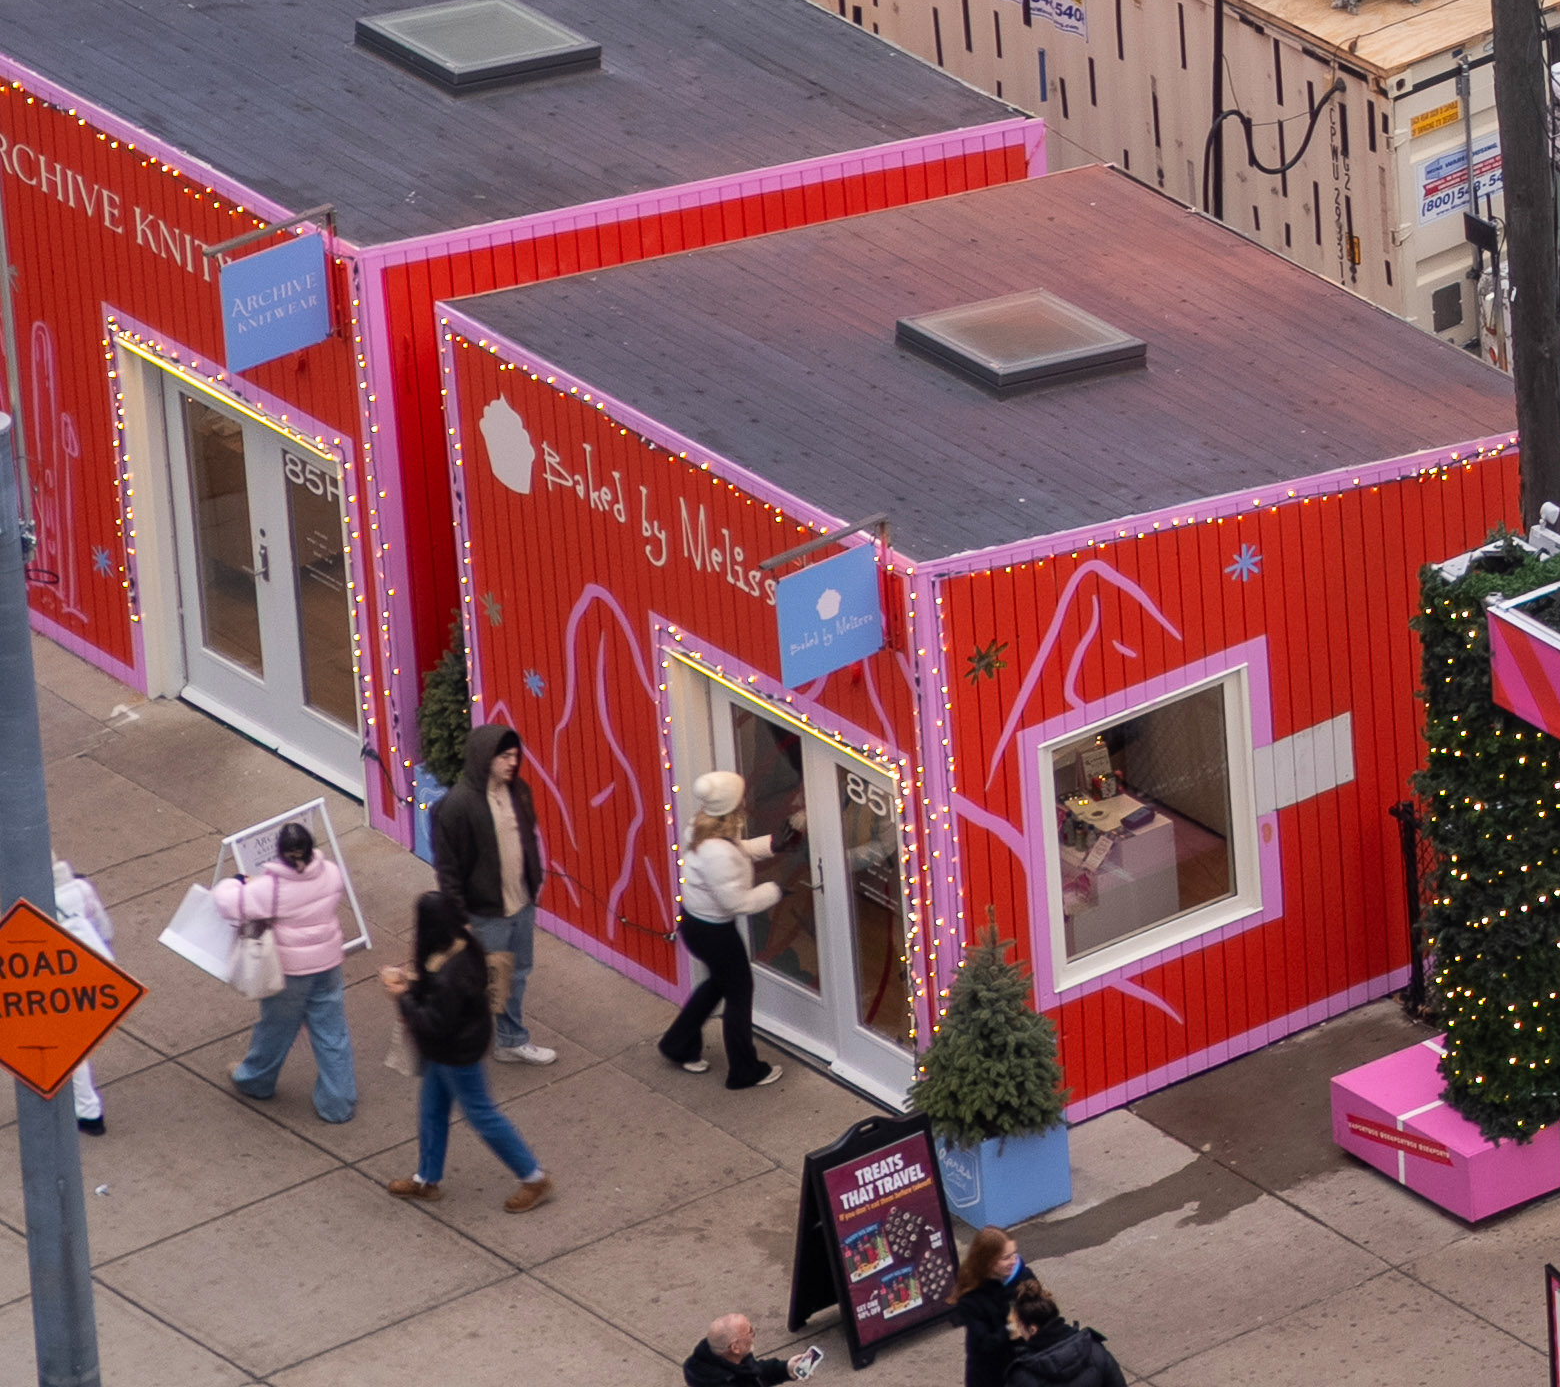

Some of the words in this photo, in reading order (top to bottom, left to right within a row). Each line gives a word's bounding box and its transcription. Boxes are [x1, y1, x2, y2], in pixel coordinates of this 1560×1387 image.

[230, 272, 319, 320] ARCHIVE
[236, 293, 319, 335] KNITWEAR
[541, 440, 627, 524] Baked
[639, 485, 668, 568] by
[678, 496, 777, 607] Meliss
[0, 982, 120, 1020] RROWS
[839, 1184, 876, 1211] THAT
[877, 1162, 926, 1200] TRAVEL
[854, 1153, 905, 1187] TREATS
